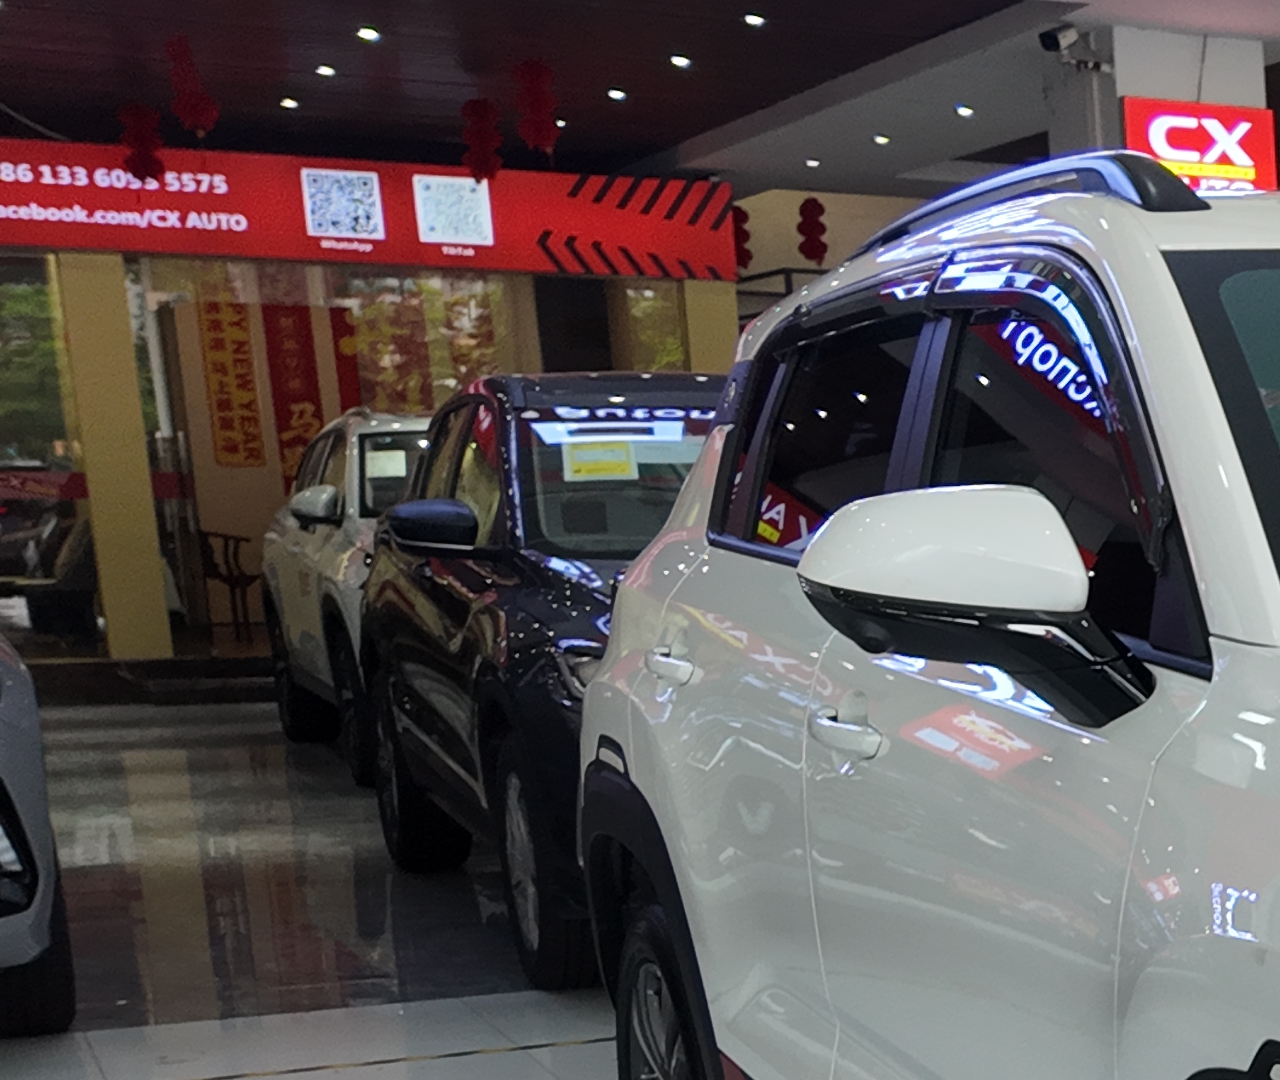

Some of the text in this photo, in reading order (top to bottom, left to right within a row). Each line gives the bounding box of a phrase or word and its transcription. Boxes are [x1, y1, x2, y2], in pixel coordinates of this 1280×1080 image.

[1148, 115, 1255, 166] CX
[38, 164, 90, 187] 133
[164, 171, 229, 194] 5575
[185, 211, 249, 232] AUTO
